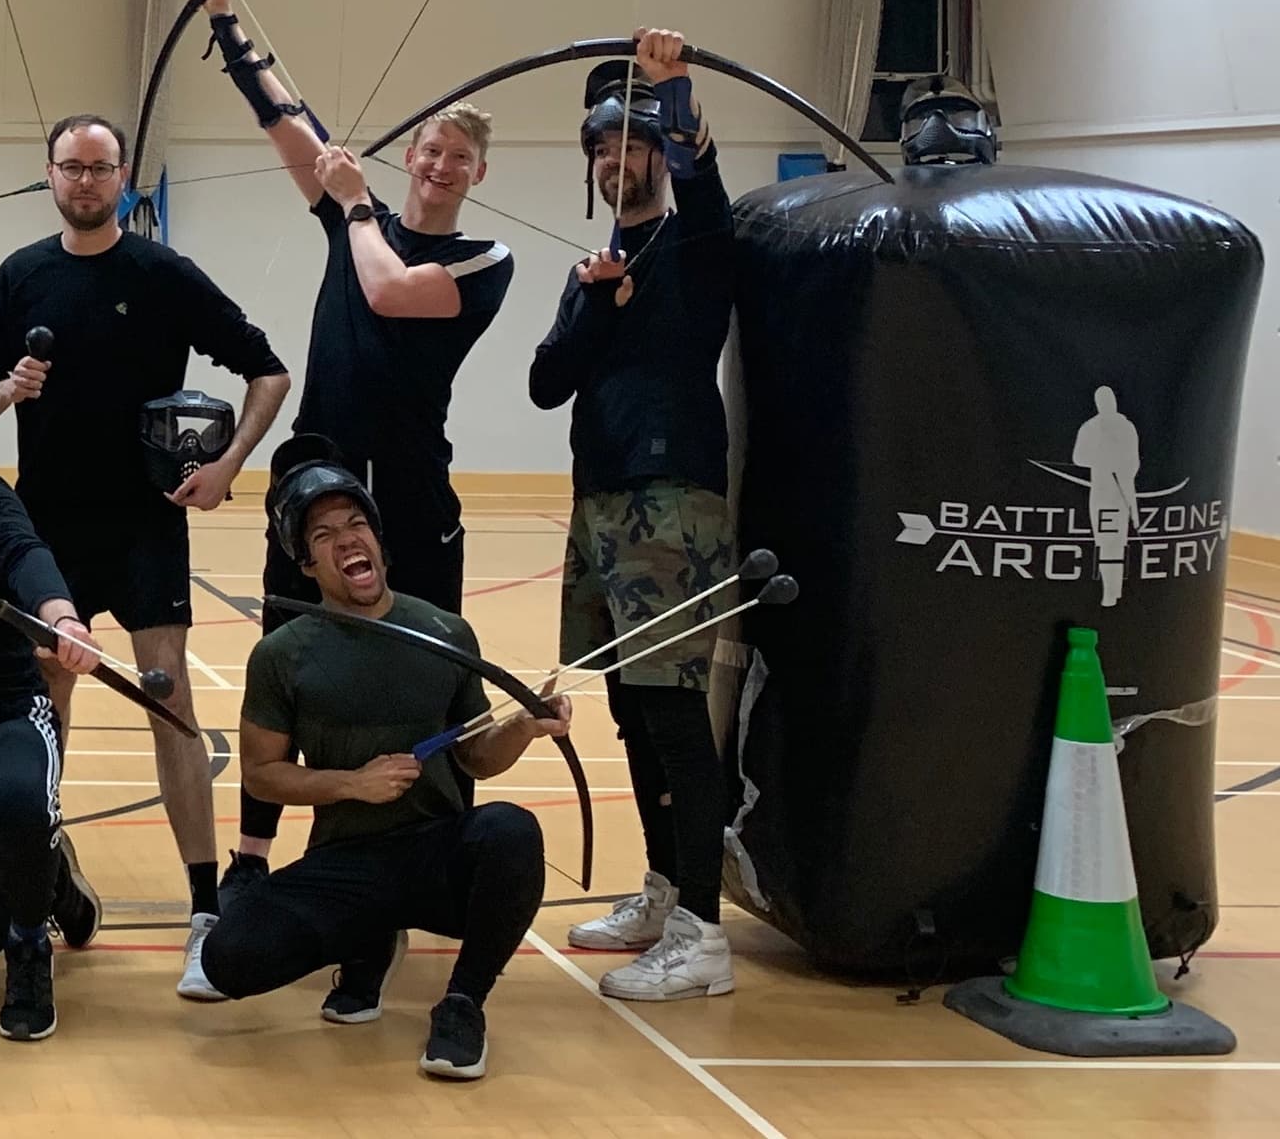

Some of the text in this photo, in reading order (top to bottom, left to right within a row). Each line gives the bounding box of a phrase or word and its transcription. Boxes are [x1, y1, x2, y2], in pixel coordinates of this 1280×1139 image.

[939, 500, 1223, 534] BATTLE ZONE
[935, 538, 1219, 580] ARCHERY
